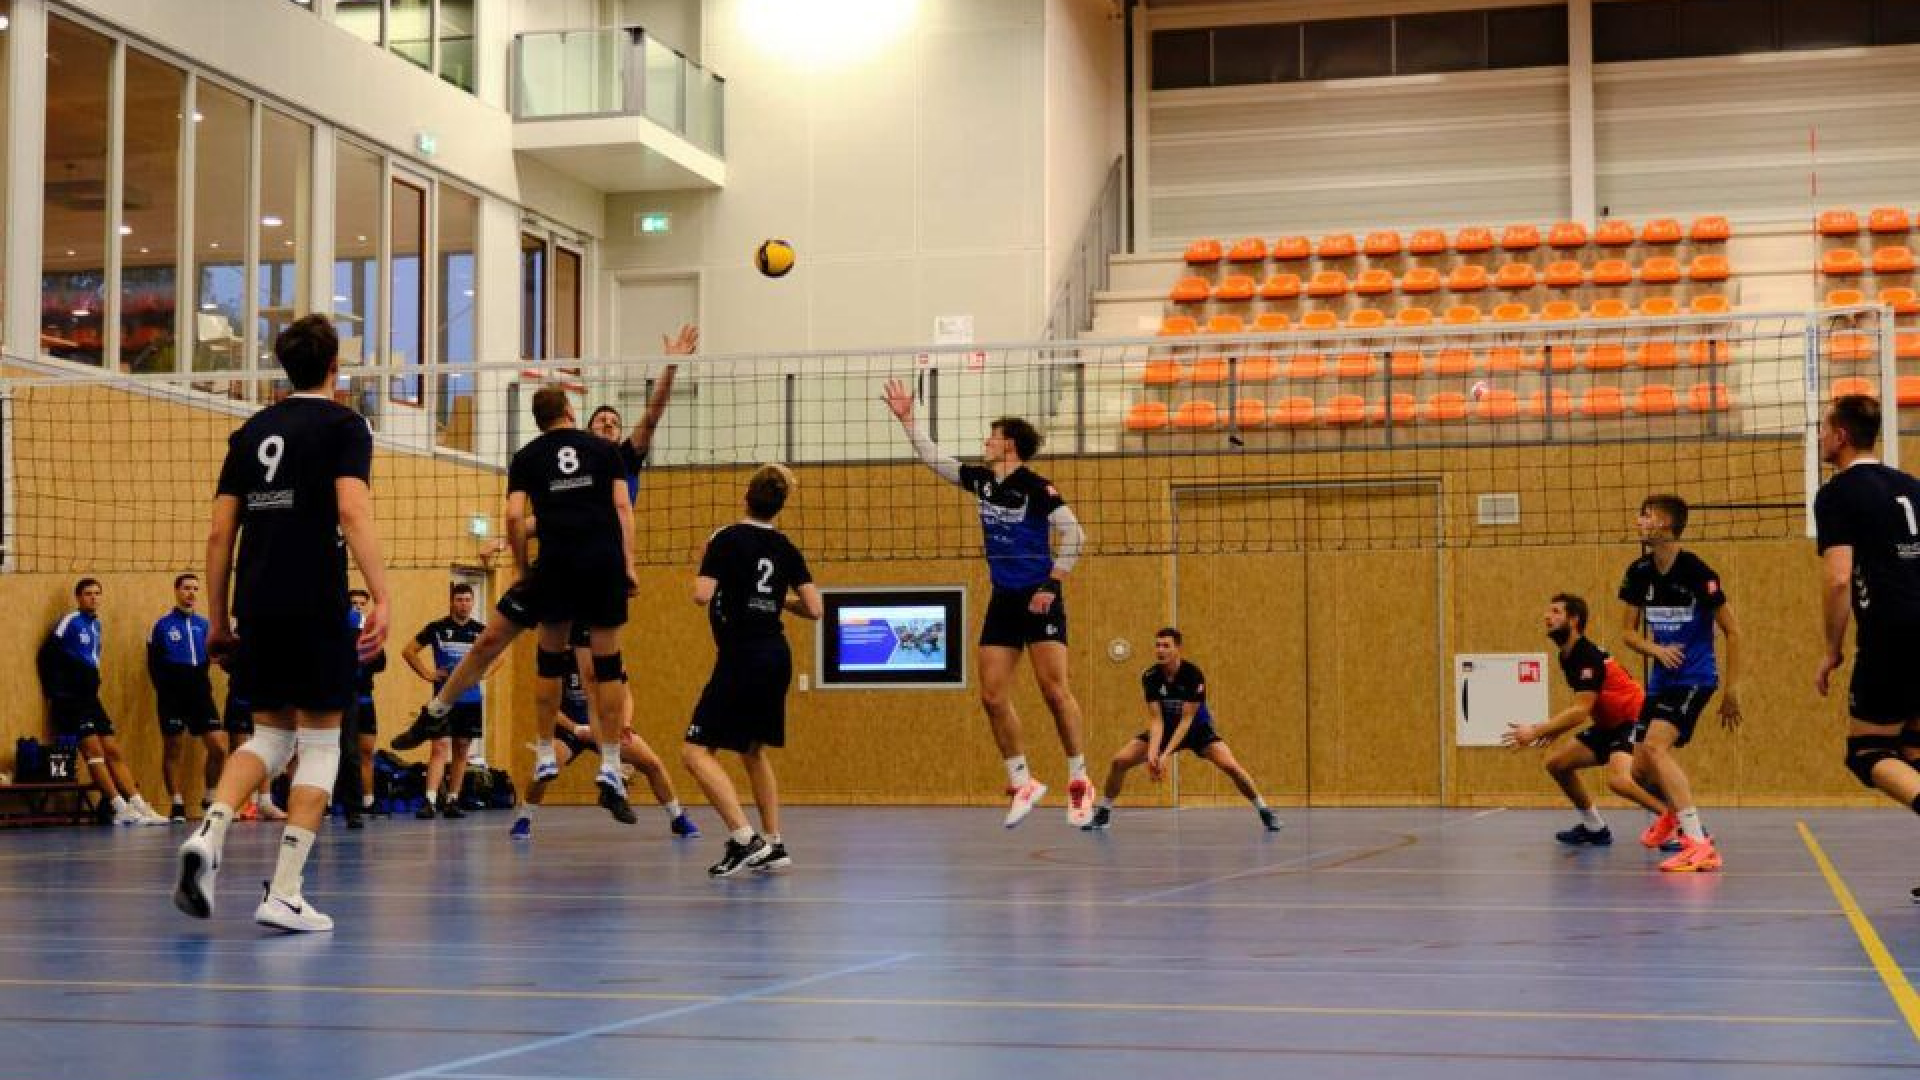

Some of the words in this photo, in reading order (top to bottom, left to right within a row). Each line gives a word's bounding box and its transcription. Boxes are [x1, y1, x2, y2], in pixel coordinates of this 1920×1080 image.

[257, 435, 285, 483] 9
[557, 445, 580, 474] 8
[757, 557, 774, 593] 2
